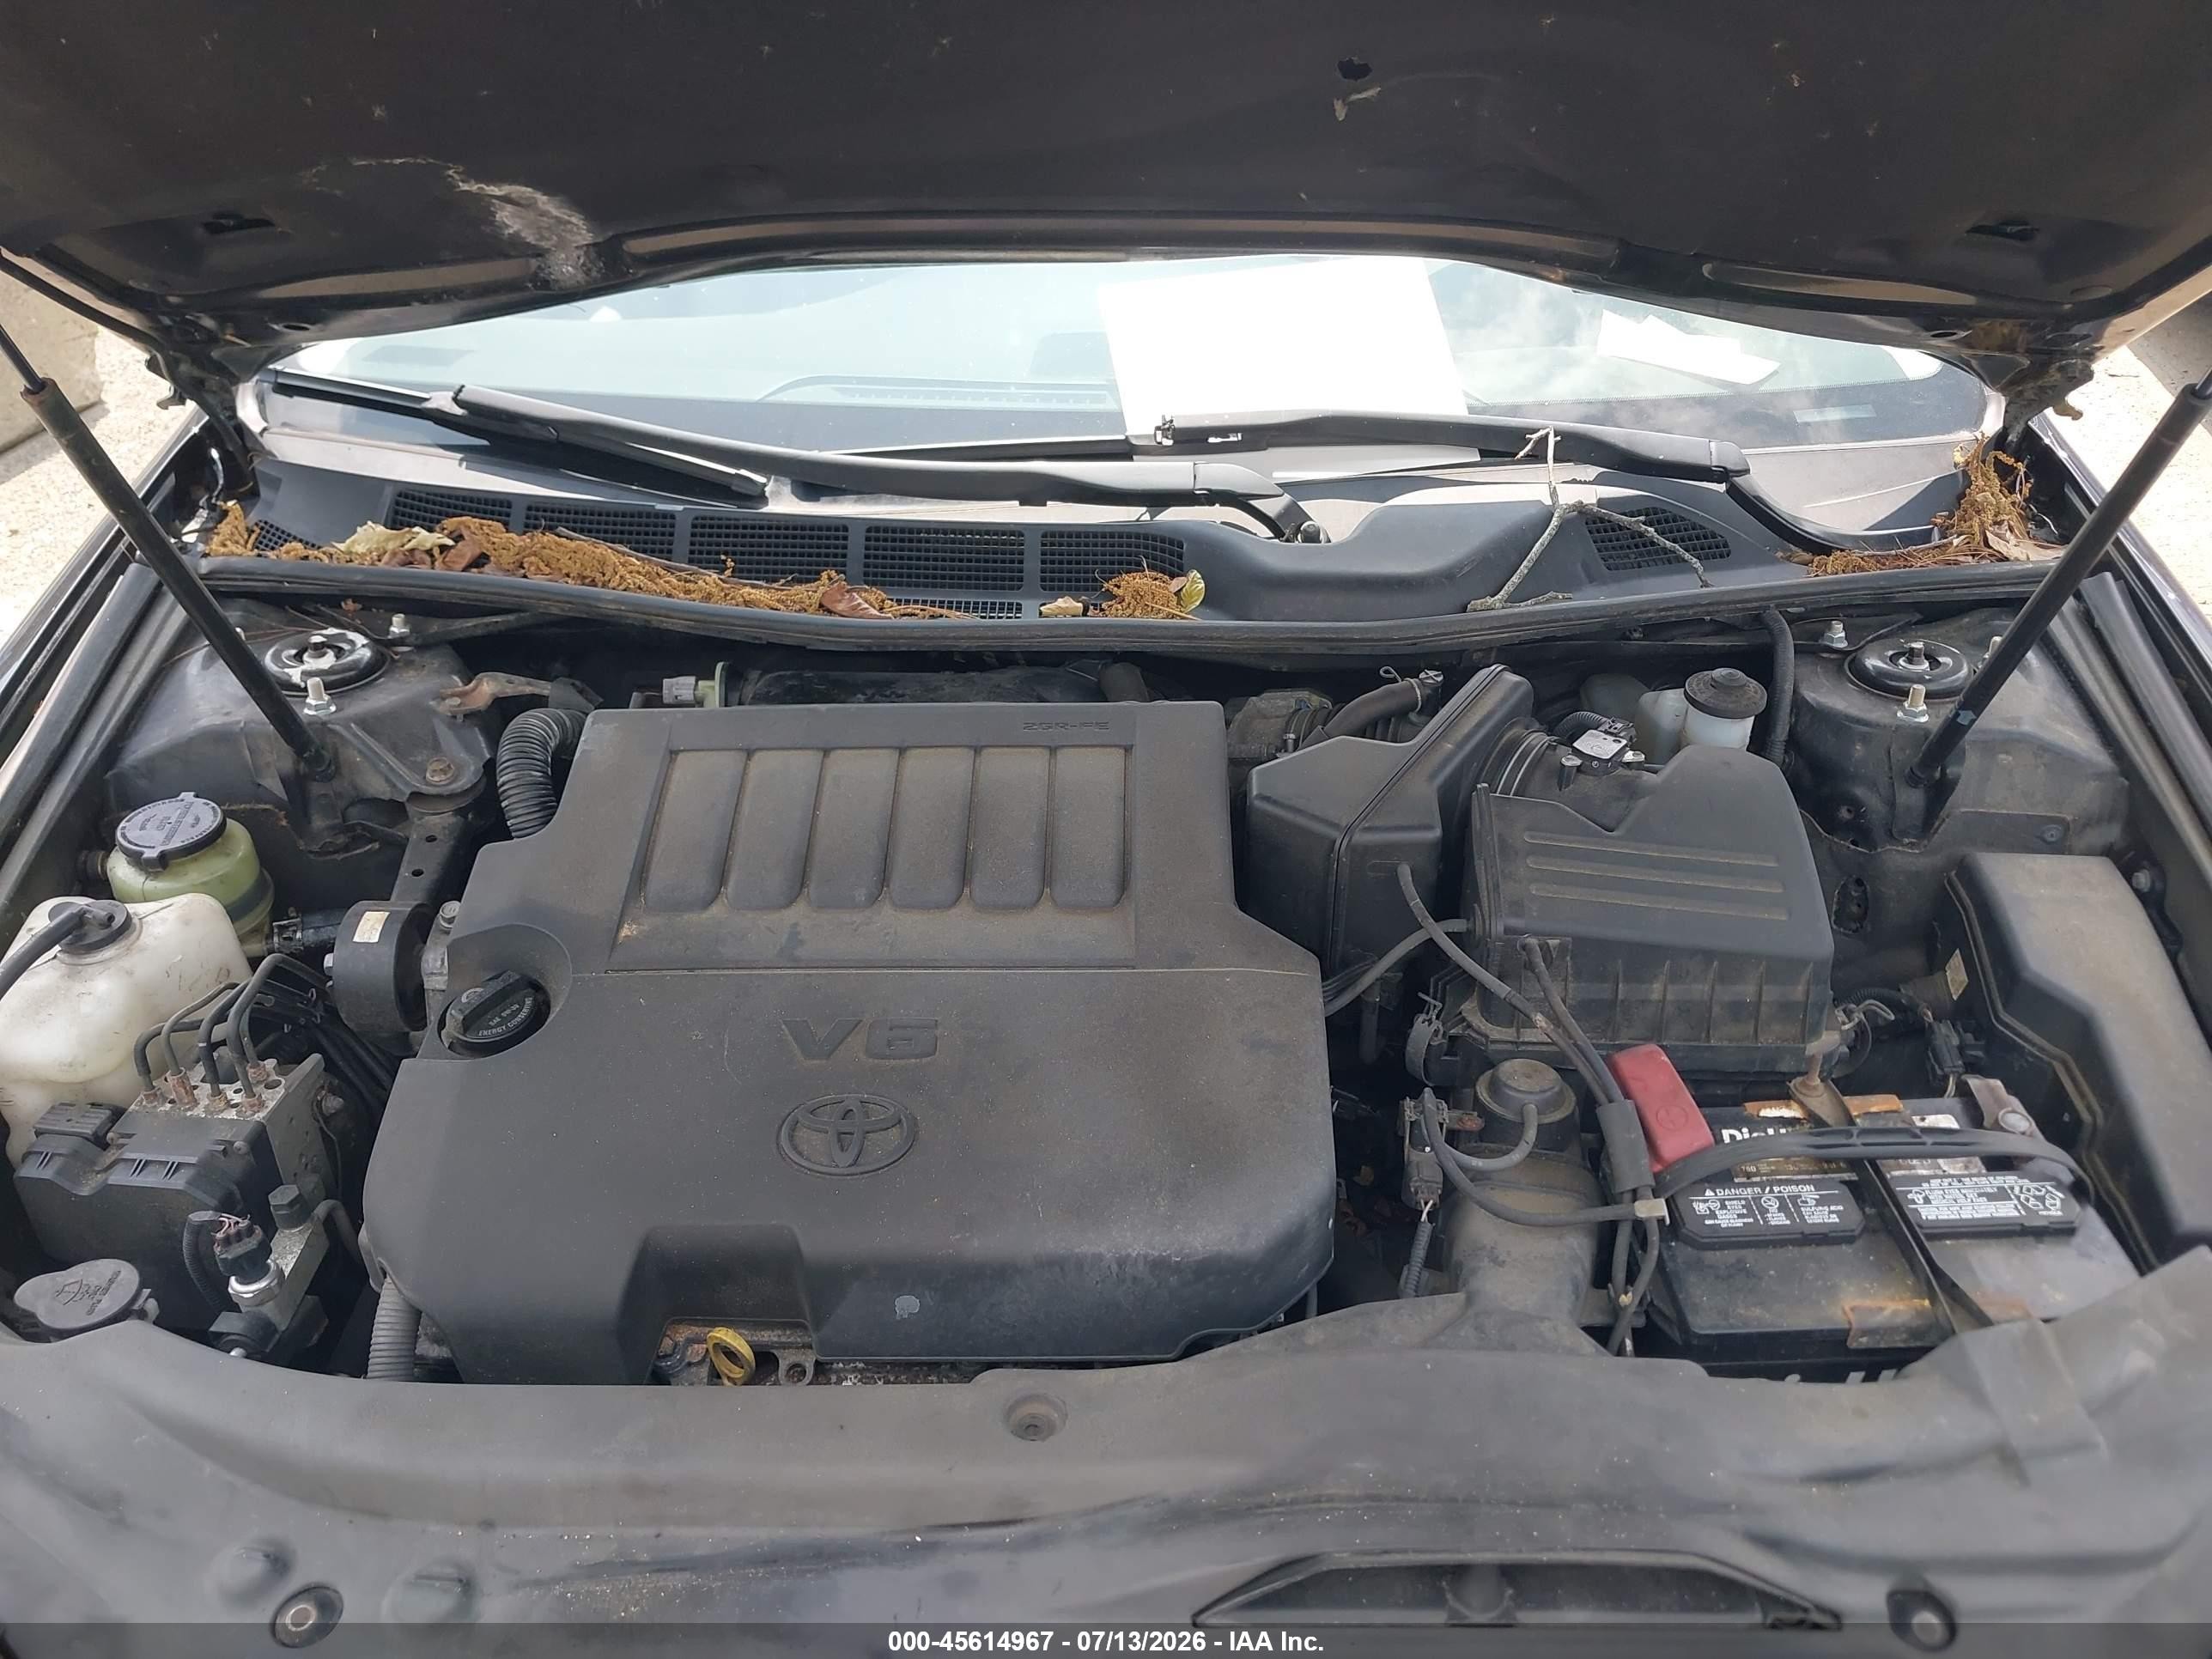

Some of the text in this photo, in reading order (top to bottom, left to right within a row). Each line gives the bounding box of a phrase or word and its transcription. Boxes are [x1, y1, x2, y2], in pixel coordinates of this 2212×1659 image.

[1023, 721, 1110, 731] 2GR-FE
[478, 996, 534, 1037] ENERGY CONSERVING
[779, 1018, 939, 1060] V6
[1716, 1187, 1762, 1196] DANGER
[1772, 1184, 1815, 1194] POISON
